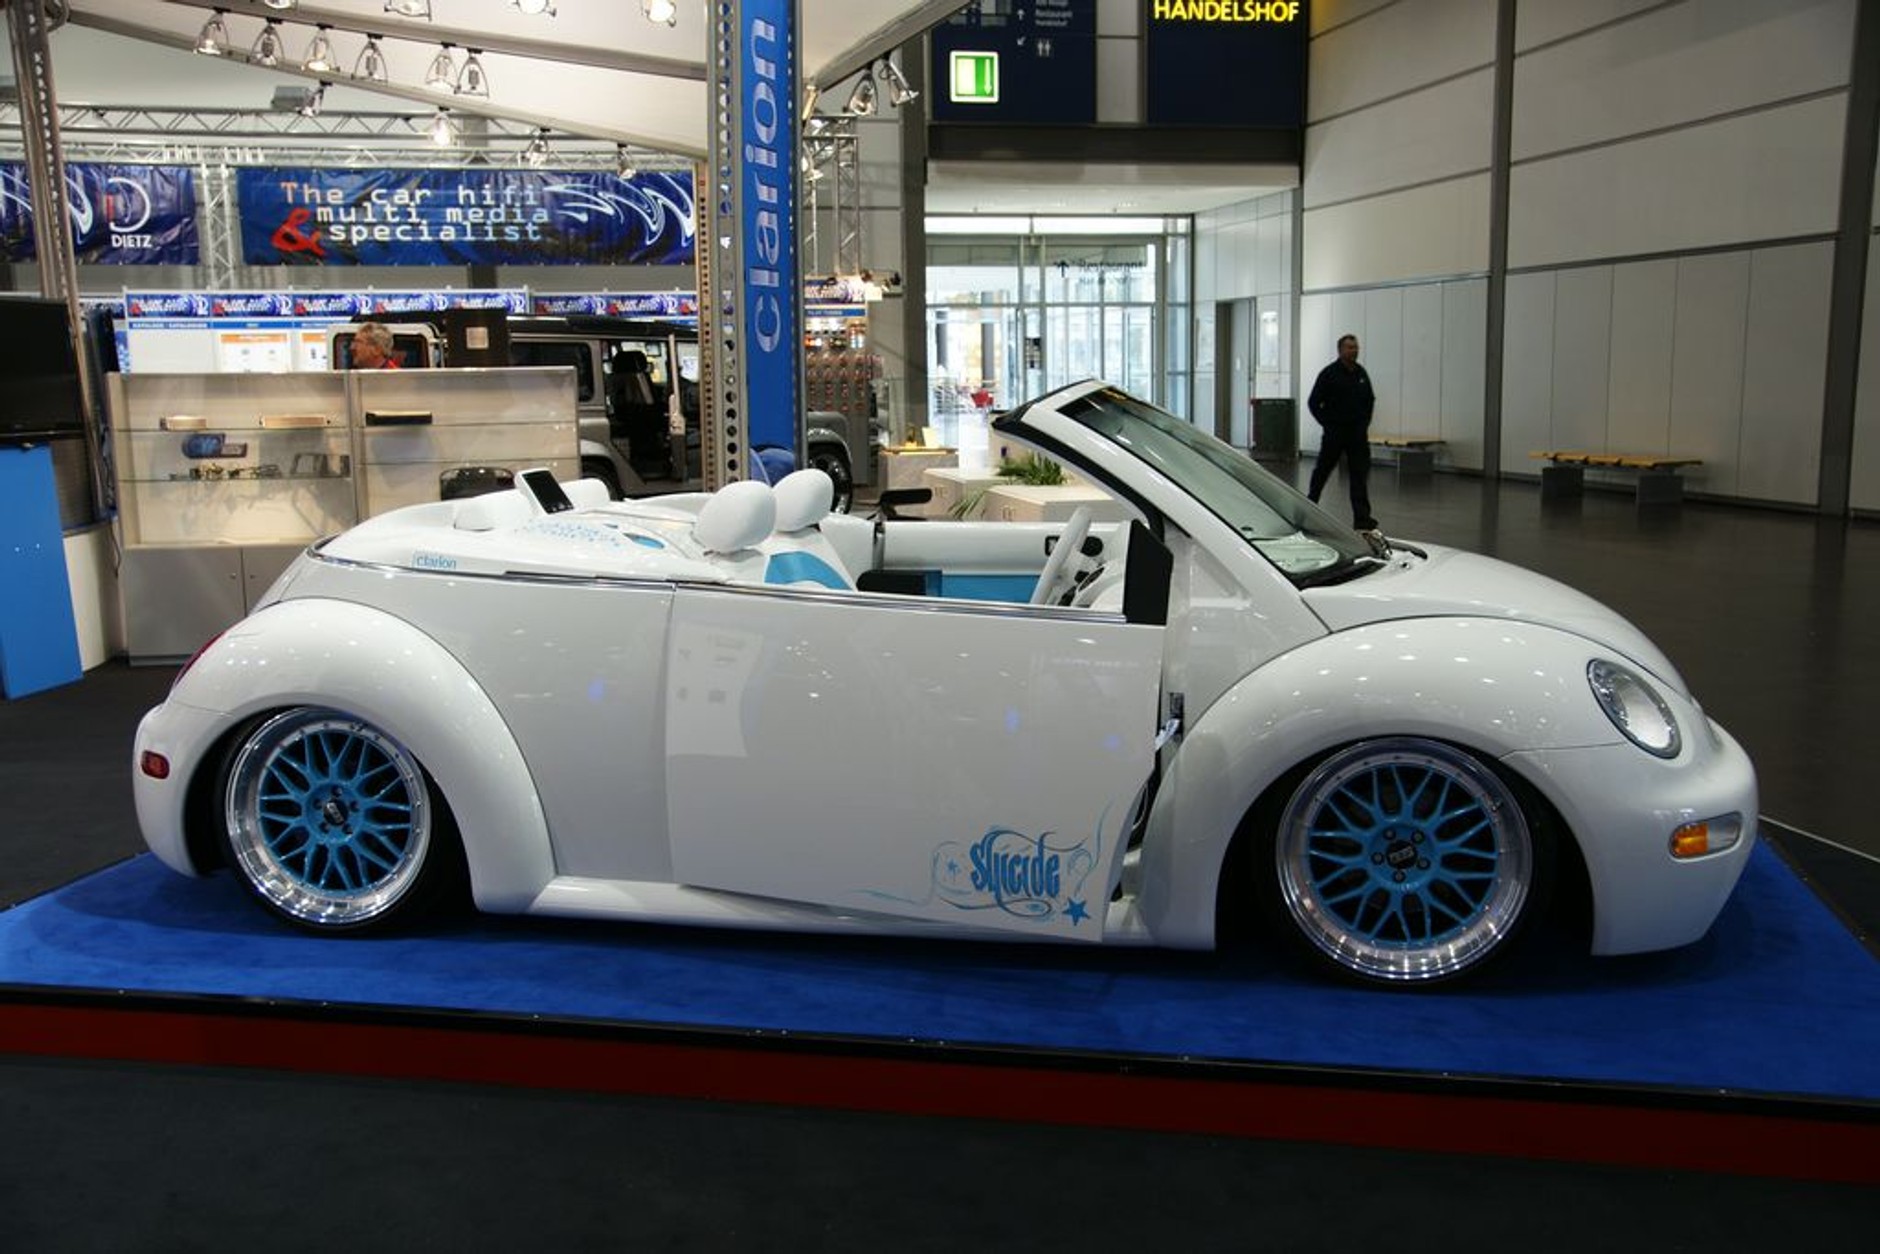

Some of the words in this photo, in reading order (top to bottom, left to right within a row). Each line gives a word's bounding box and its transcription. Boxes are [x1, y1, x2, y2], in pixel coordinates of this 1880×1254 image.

[1154, 0, 1299, 21] HANDELSHOF
[281, 182, 344, 204] The
[370, 188, 432, 204] car
[458, 184, 538, 205] hifi
[270, 206, 326, 257] &
[316, 201, 420, 222] multi
[446, 203, 549, 222] media
[329, 220, 541, 246] specialist
[111, 234, 153, 248] DIETZ
